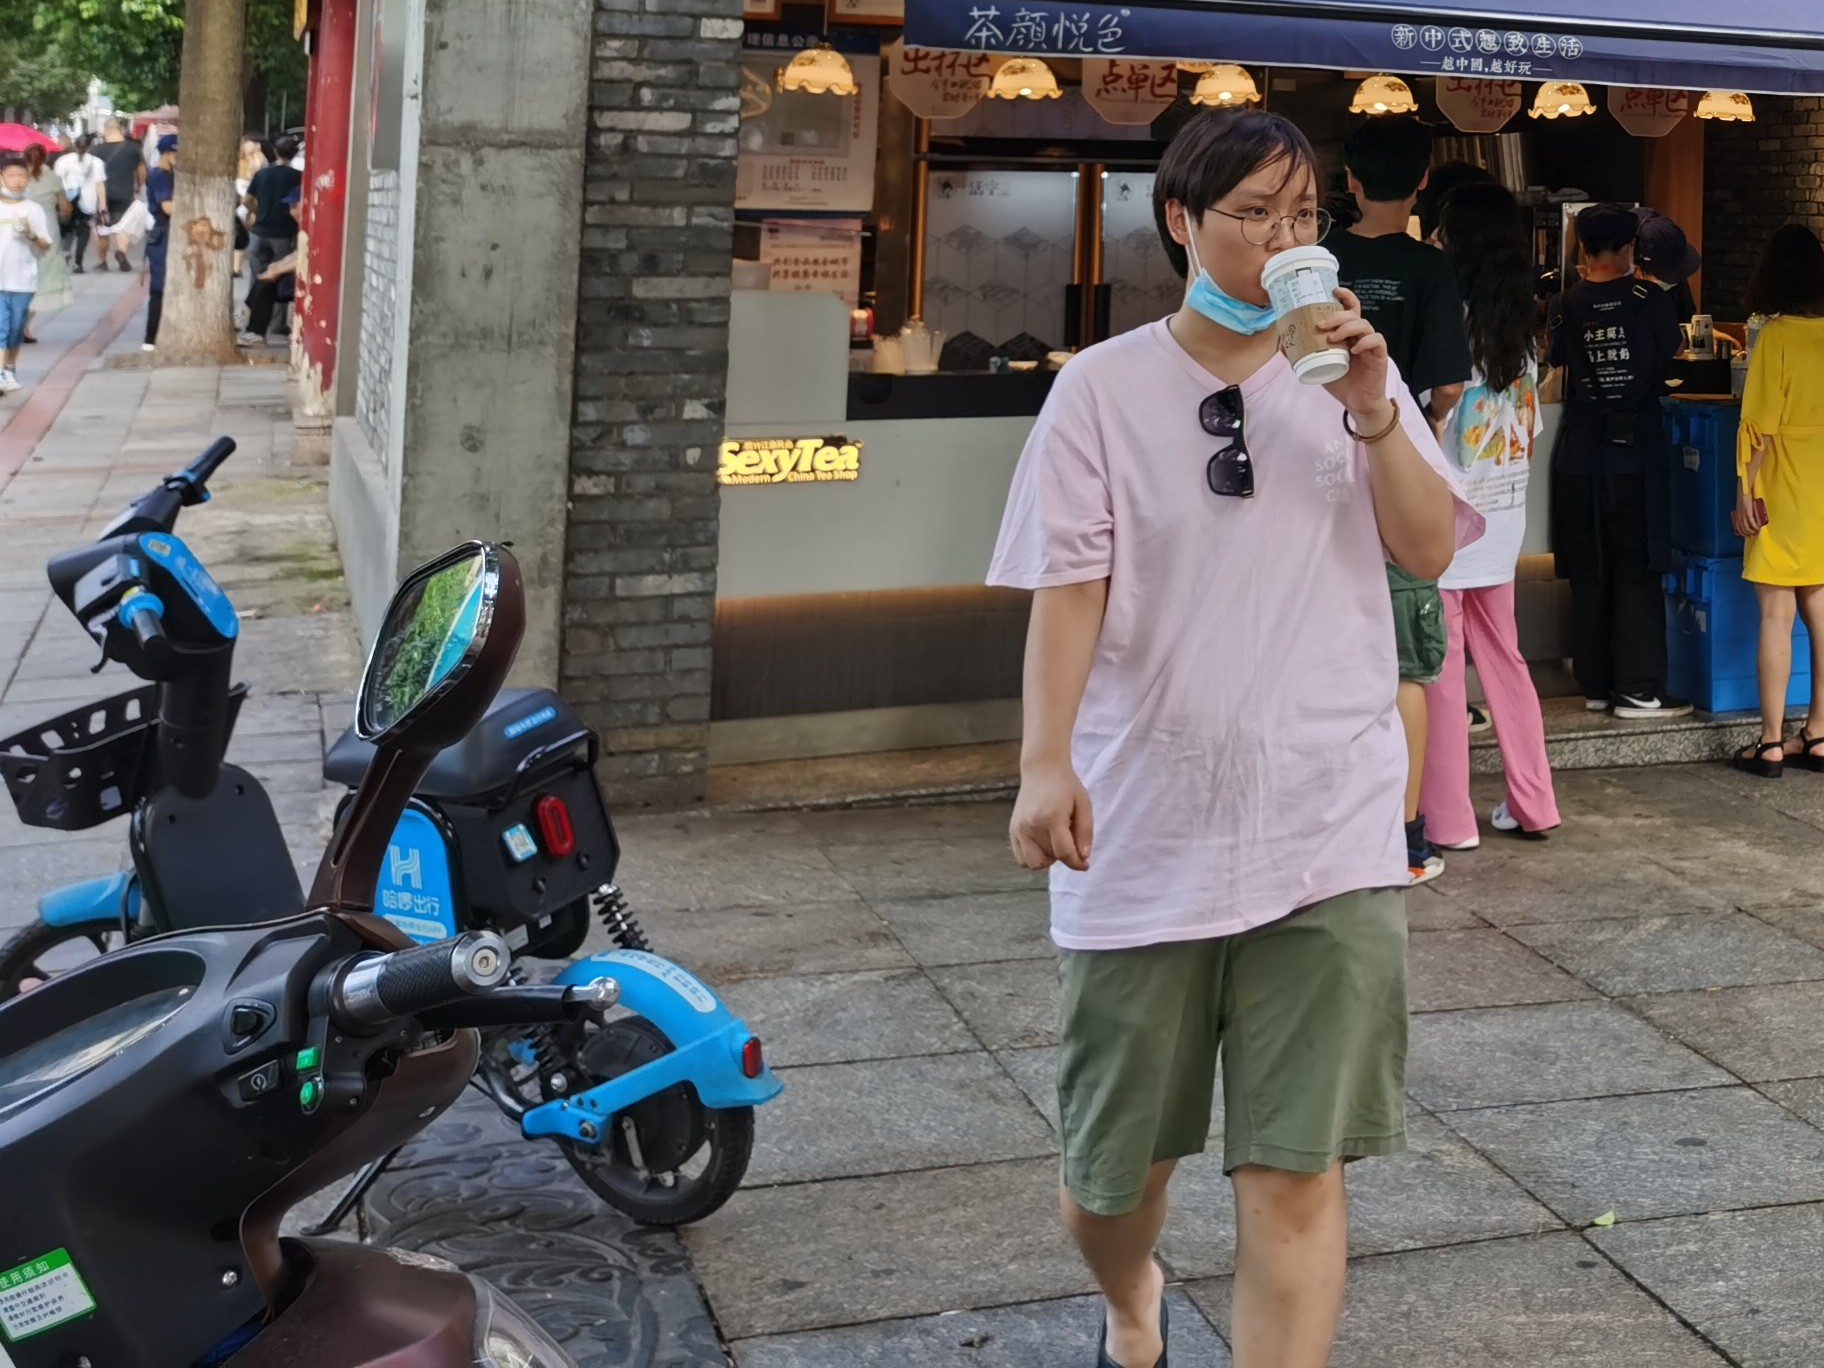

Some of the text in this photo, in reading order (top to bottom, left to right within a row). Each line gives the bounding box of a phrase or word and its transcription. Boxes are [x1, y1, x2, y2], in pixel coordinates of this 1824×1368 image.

[1391, 23, 1584, 60] 新中式趣致生活
[718, 438, 860, 483] SexyTea
